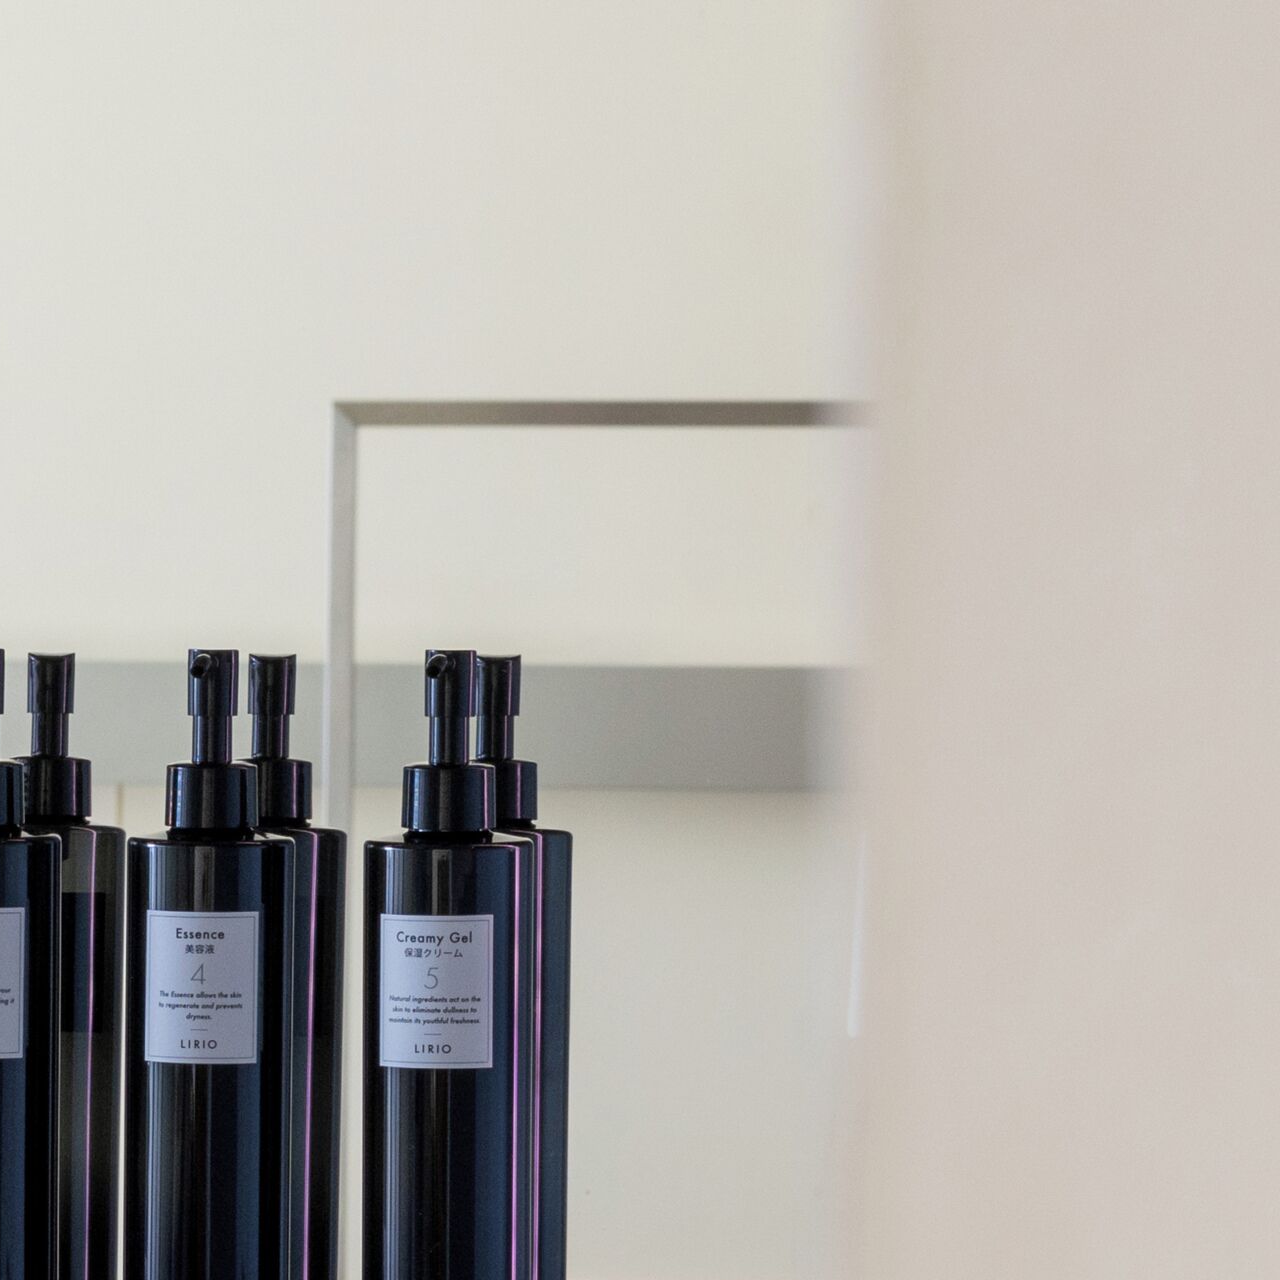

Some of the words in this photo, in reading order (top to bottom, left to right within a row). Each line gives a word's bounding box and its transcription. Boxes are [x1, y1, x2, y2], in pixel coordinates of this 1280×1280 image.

[176, 928, 225, 939] Essence
[396, 931, 444, 946] Creamy
[449, 932, 473, 944] Gel
[185, 944, 215, 954] 美容液
[404, 948, 463, 958] 保湿クリーム
[190, 963, 206, 984] 4
[424, 967, 439, 989] 5
[412, 996, 447, 1004] ingredients
[422, 1018, 449, 1026] youthful
[180, 1039, 218, 1049] LIRIO
[414, 1044, 452, 1054] LIRIO
